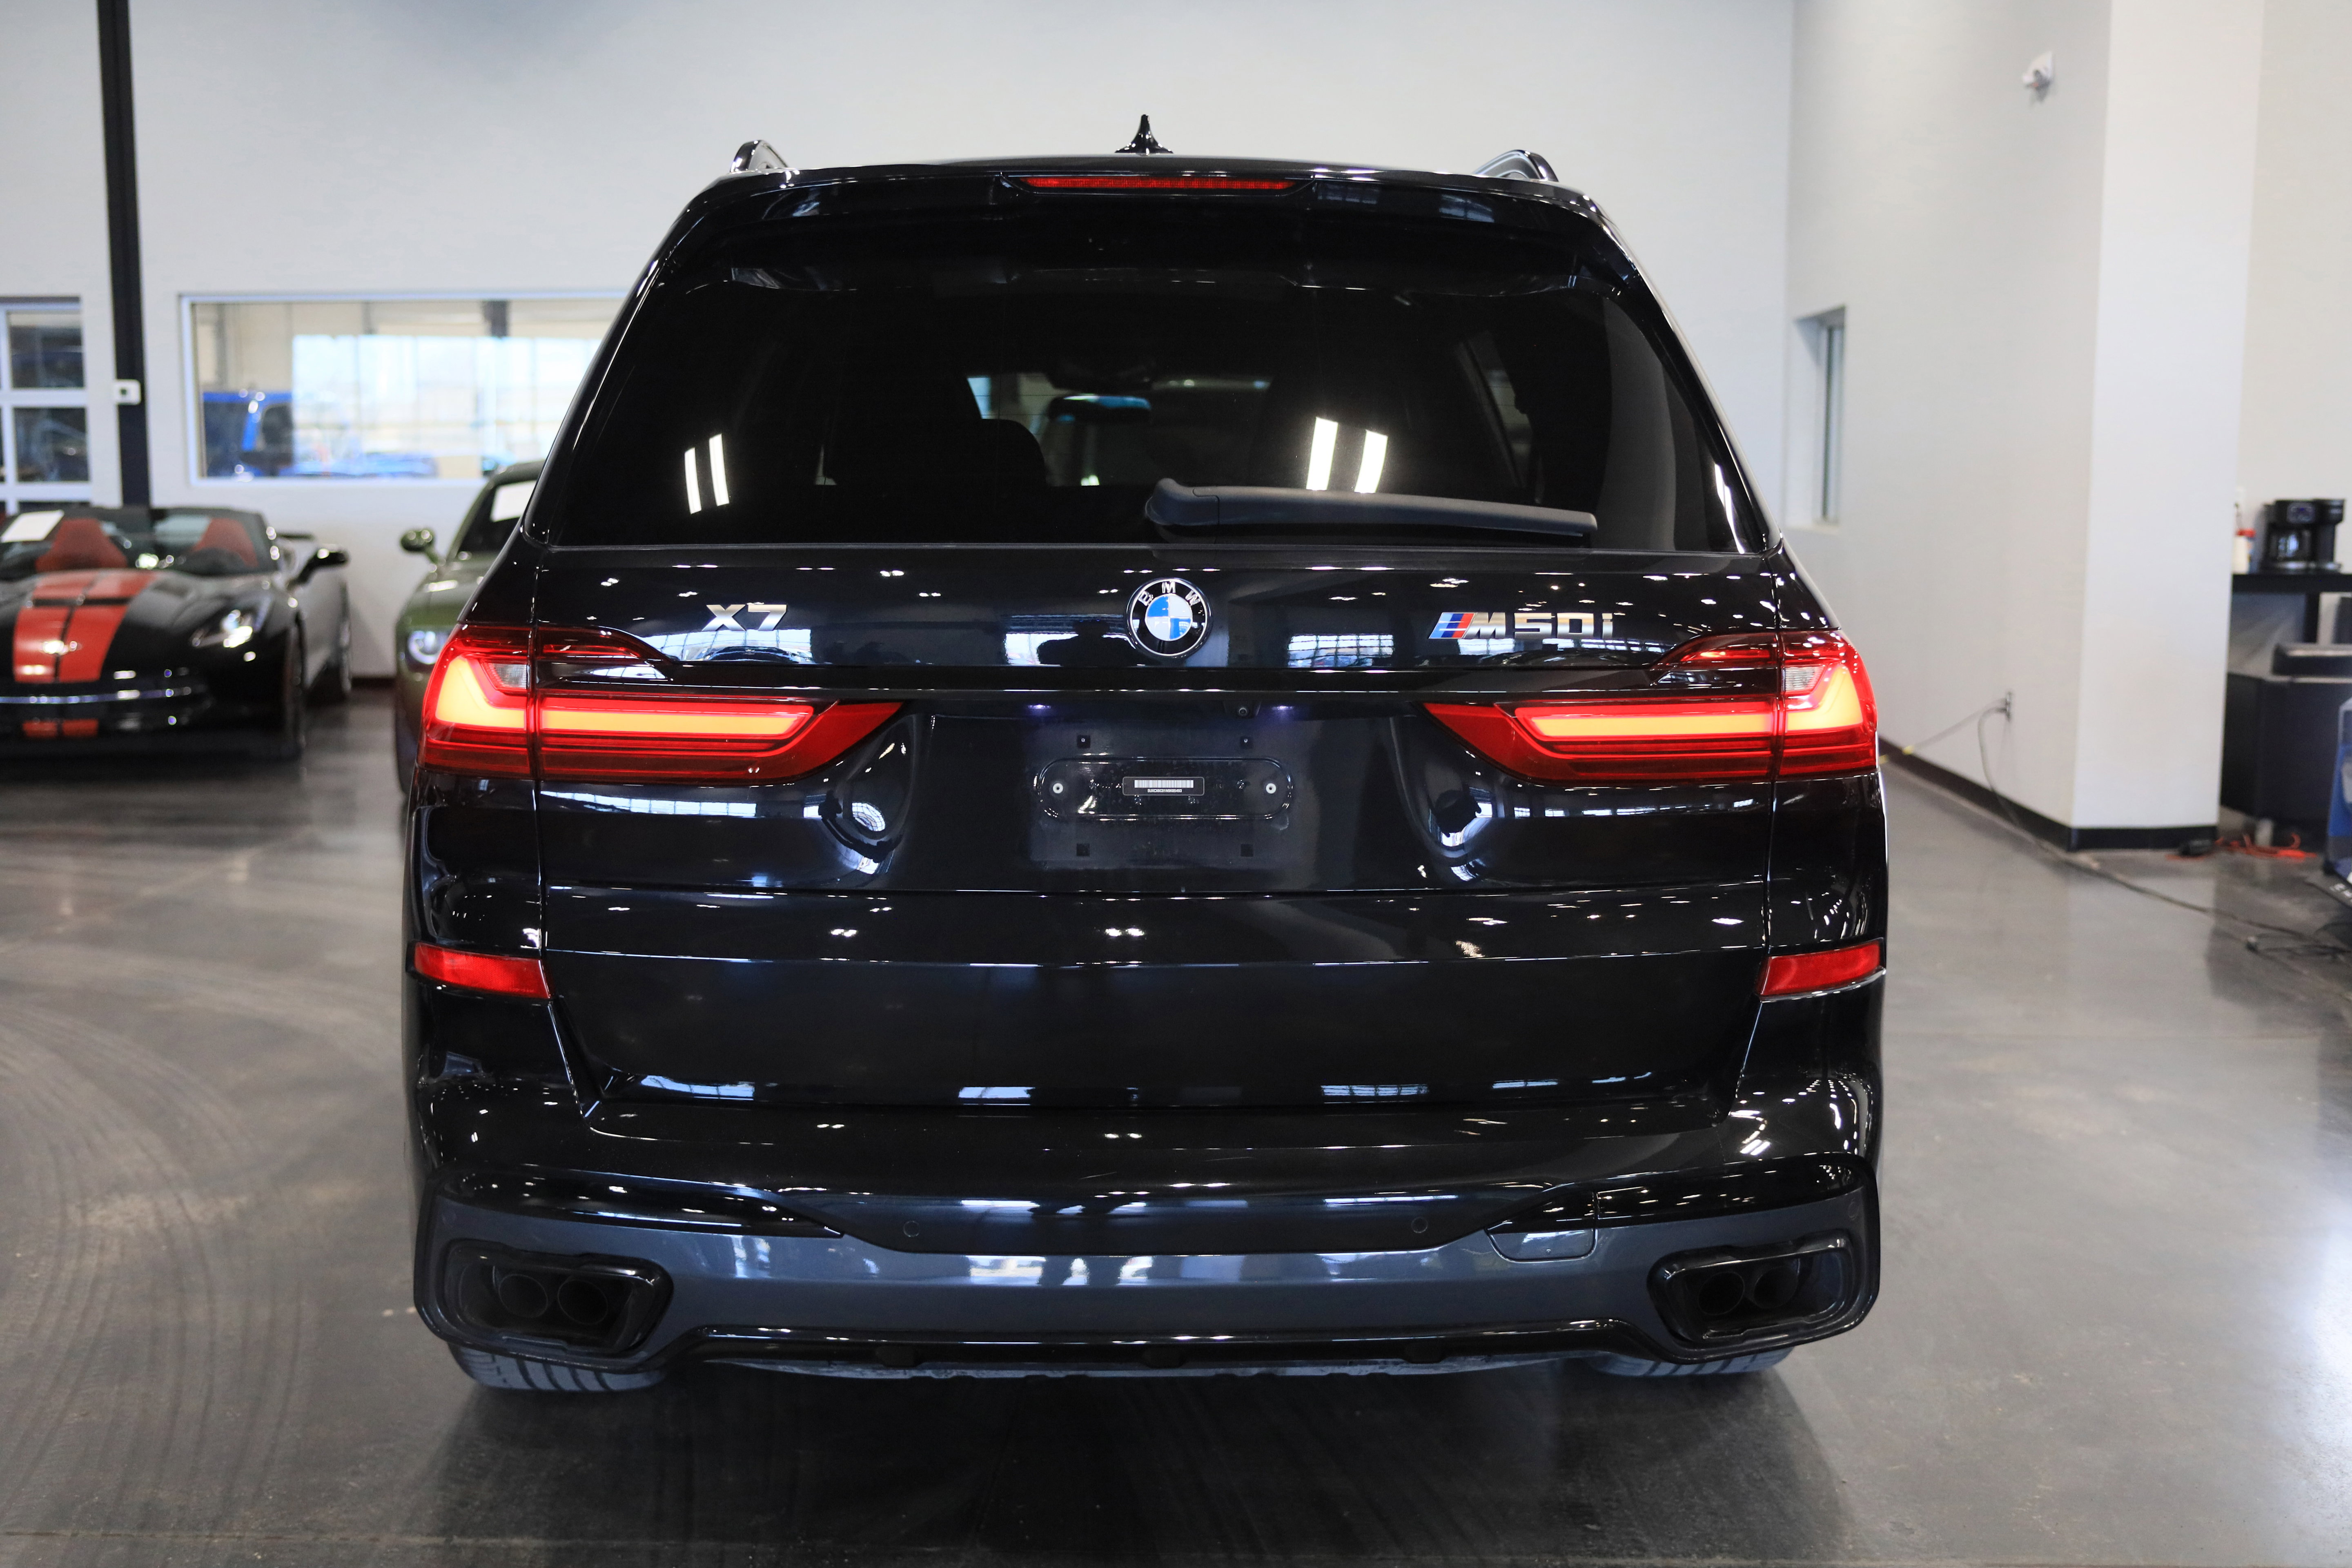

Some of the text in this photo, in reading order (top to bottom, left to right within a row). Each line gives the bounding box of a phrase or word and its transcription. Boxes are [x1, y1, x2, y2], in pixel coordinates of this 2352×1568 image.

[1138, 581, 1200, 606] BMW
[702, 604, 787, 631] X7
[1463, 612, 1613, 639] M50i
